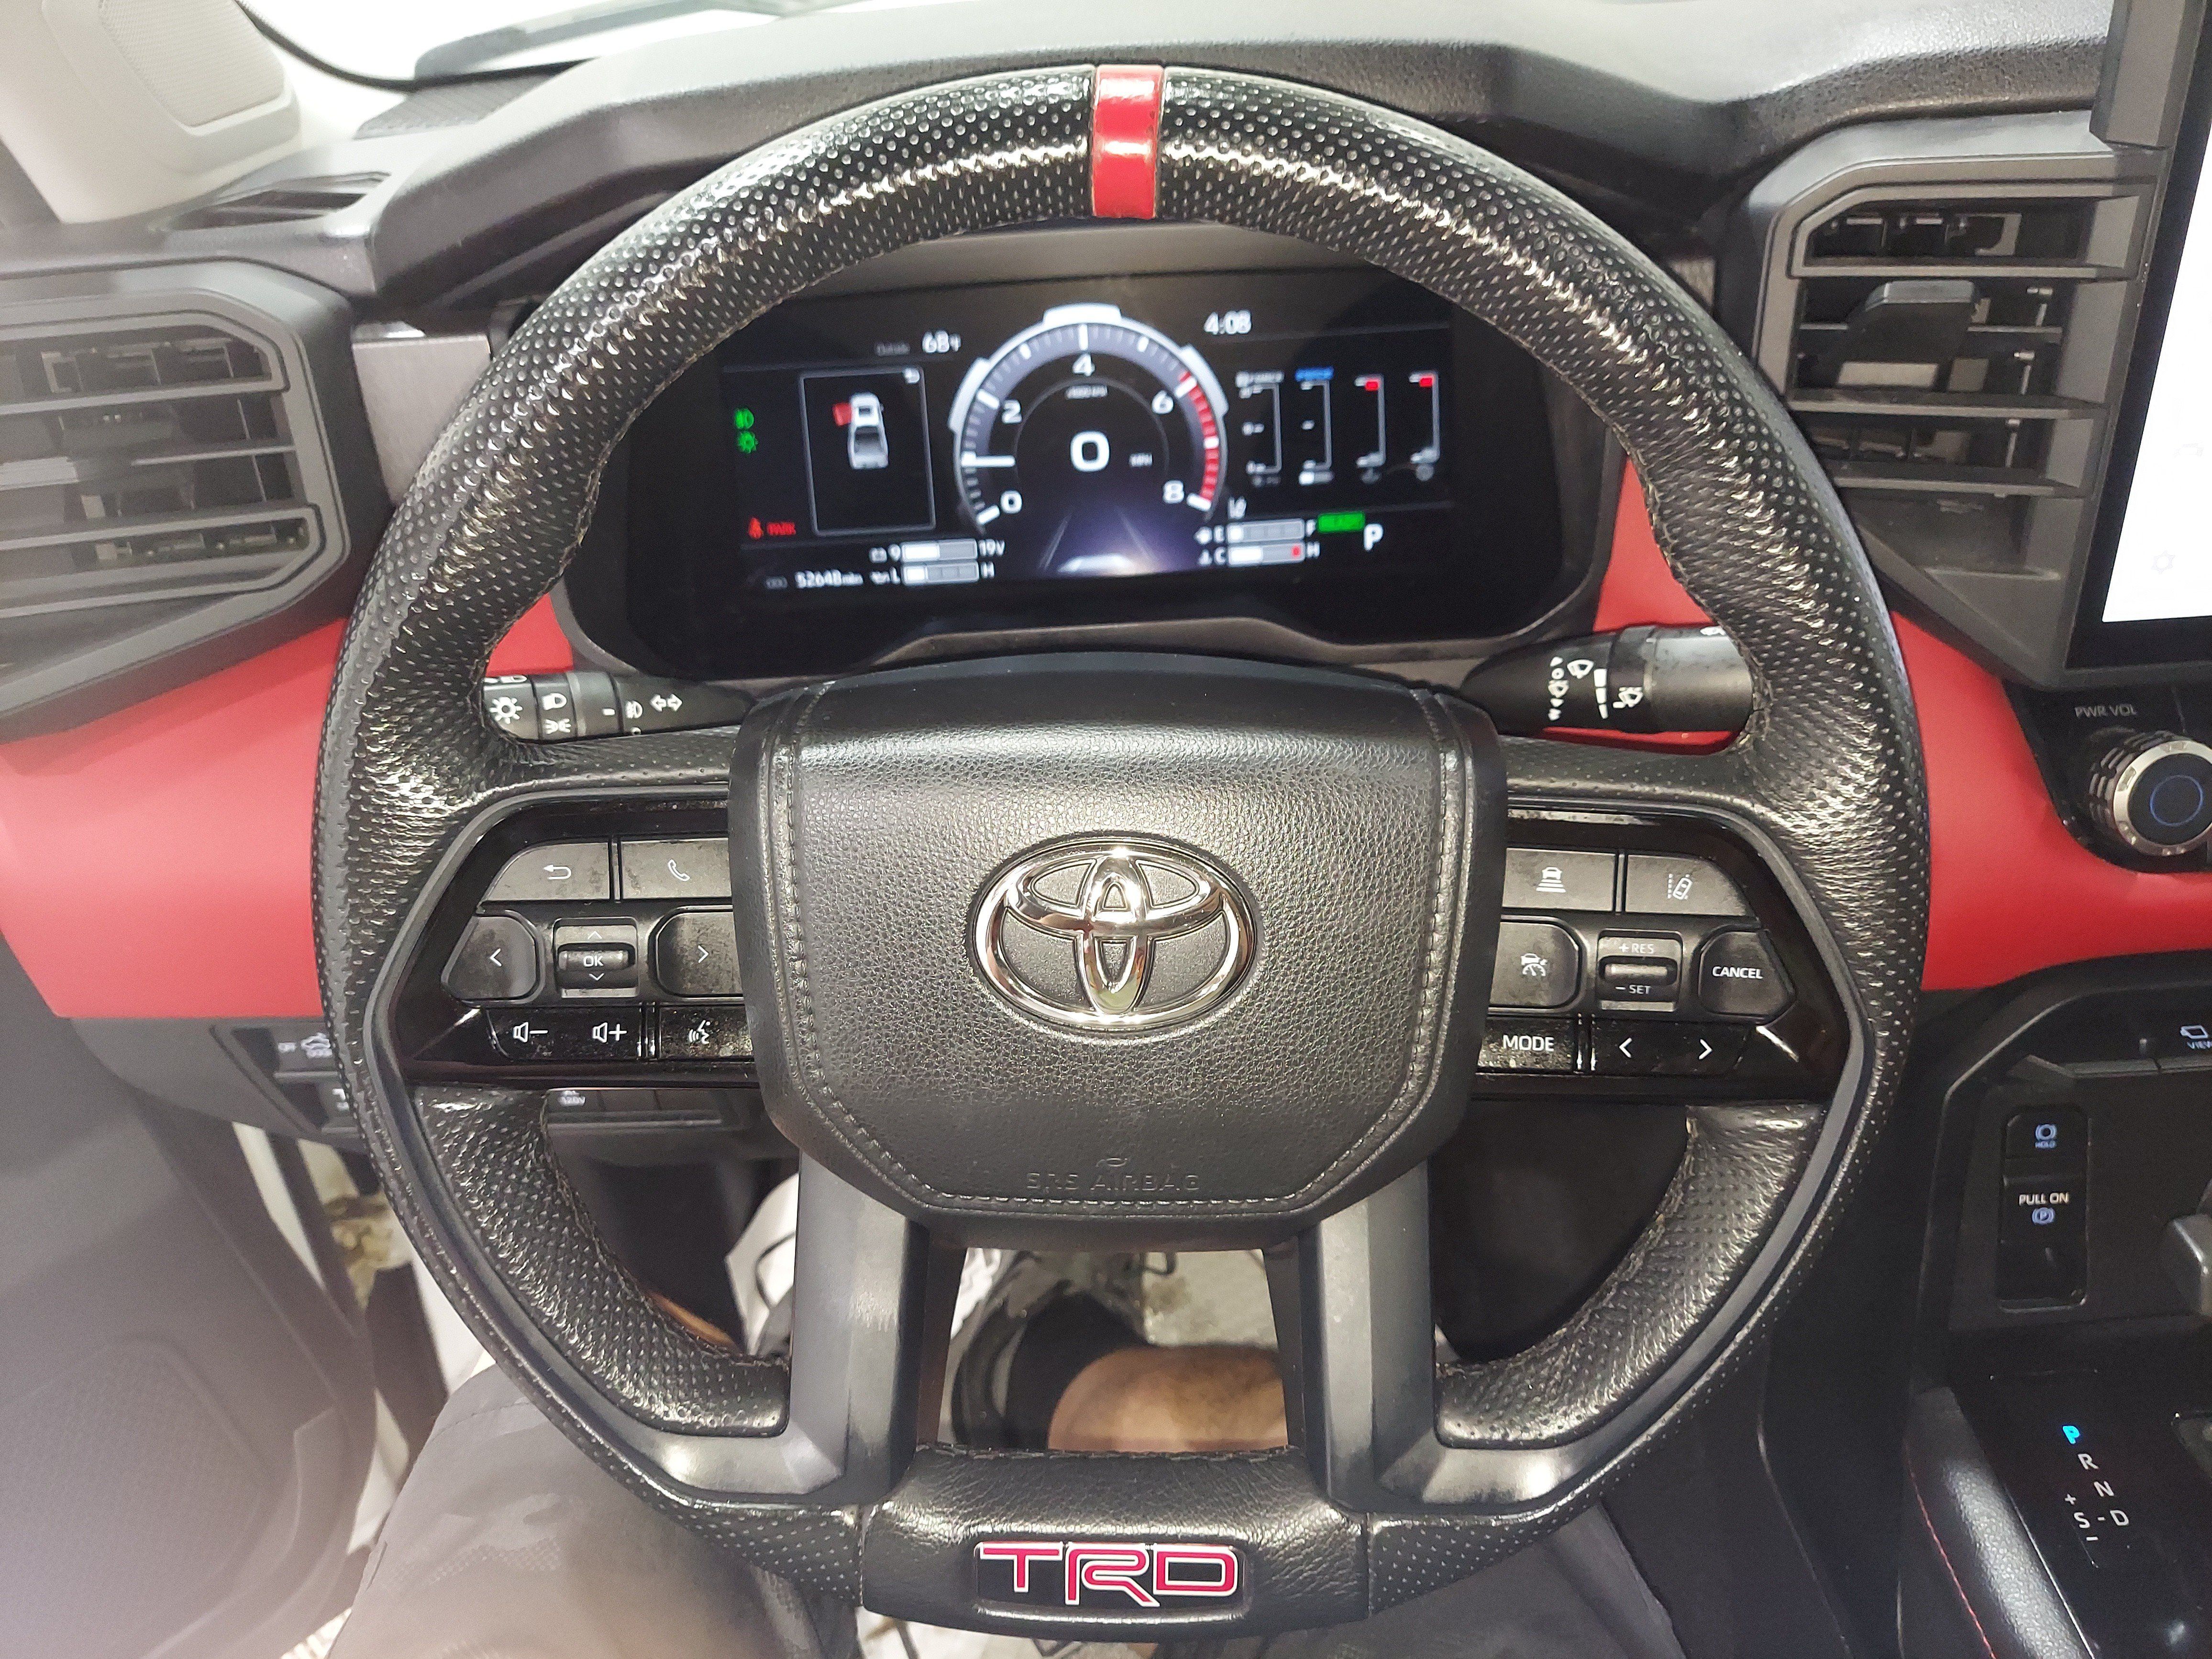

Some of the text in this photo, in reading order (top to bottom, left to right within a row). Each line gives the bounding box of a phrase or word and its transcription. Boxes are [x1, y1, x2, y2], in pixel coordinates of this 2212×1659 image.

[1072, 353, 1095, 376] 4
[1002, 399, 1022, 424] 2
[1151, 390, 1174, 414] 6
[1070, 431, 1110, 472] 0
[1162, 480, 1184, 504] 8
[1000, 490, 1023, 514] 0
[1364, 523, 1384, 551] P
[2075, 704, 2136, 718] PWR VOL
[584, 955, 604, 967] OK
[1712, 965, 1763, 979] CANCEL
[1629, 984, 1651, 995] SET
[1503, 1034, 1555, 1053] MODE
[2019, 1192, 2069, 1206] PULL ON
[2062, 1426, 2080, 1444] P
[2078, 1453, 2099, 1470] R
[2093, 1481, 2114, 1497] N
[2074, 1509, 2130, 1528] S D
[979, 1542, 1239, 1607] TRD
